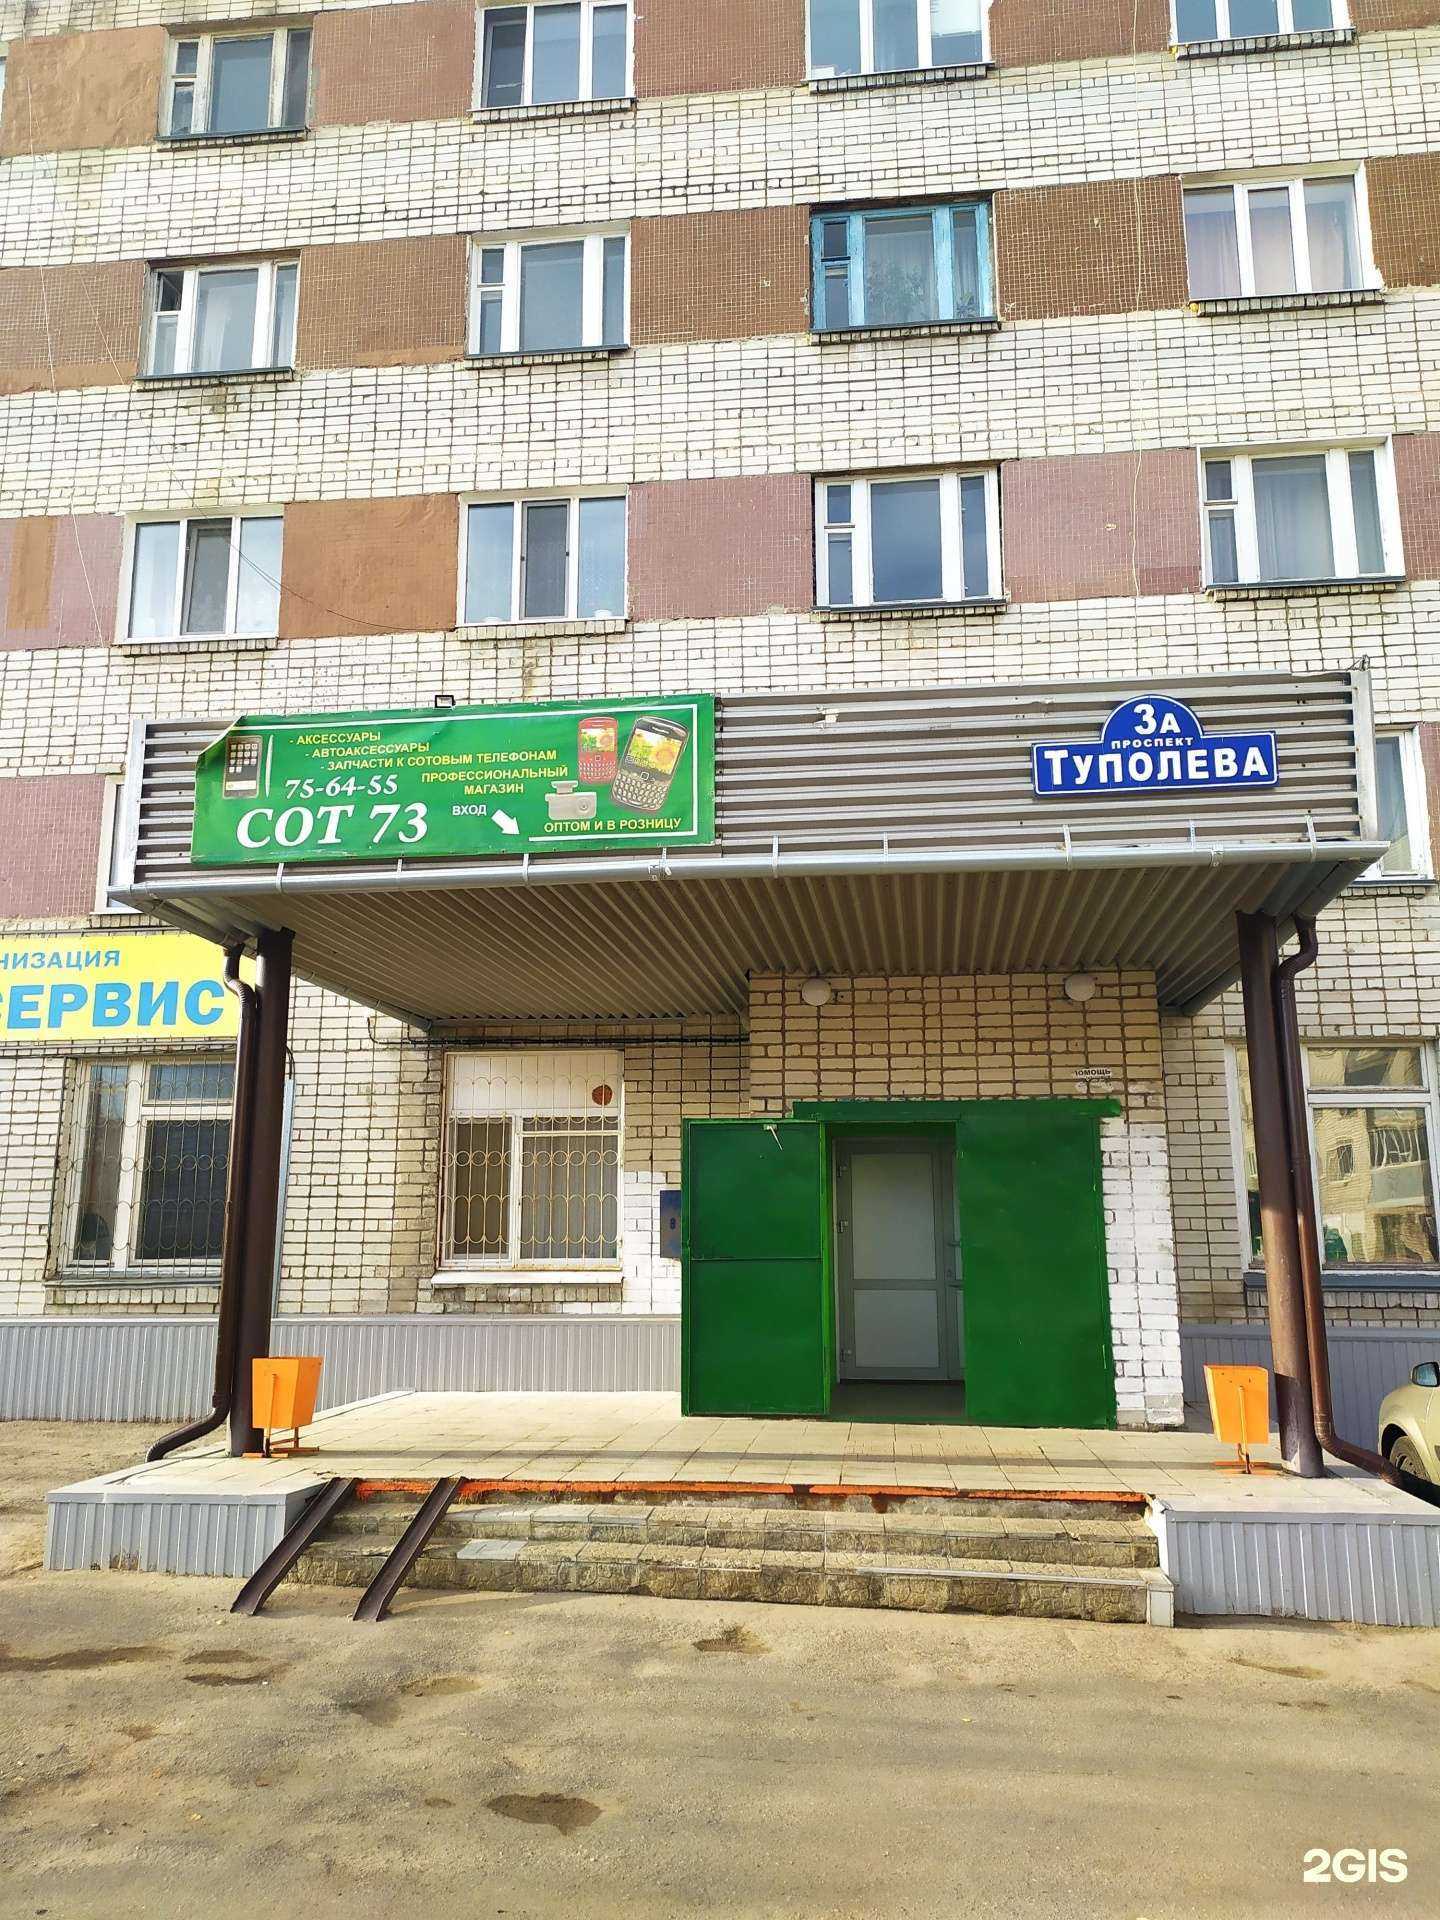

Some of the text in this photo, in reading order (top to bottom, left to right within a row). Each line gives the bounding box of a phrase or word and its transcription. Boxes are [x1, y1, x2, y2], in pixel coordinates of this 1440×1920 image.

[1133, 703, 1181, 735] 3А
[297, 732, 381, 745] АКСЕССУАРЫ
[1111, 737, 1194, 750] ПРОСПЕКТ
[312, 743, 430, 758] АВТОАКСЕССУАРЫ
[327, 750, 557, 771] ЗАПЧАСТИ К СОТОВЫМ ТЕЛЕФОНАМ
[1044, 747, 1269, 785] ТУПОЛЕВА
[422, 765, 568, 783] ПРОФЕССИОНАЛЬНЫЙ
[285, 774, 398, 800] 75-64-55
[464, 783, 524, 795] МАГАЗИН
[452, 804, 487, 817] ВХОД
[236, 802, 428, 849] СОТ 73
[544, 818, 682, 833] ОПТОМ И В РОЗНИЦУ
[0, 980, 225, 1029] ЕРВИС
